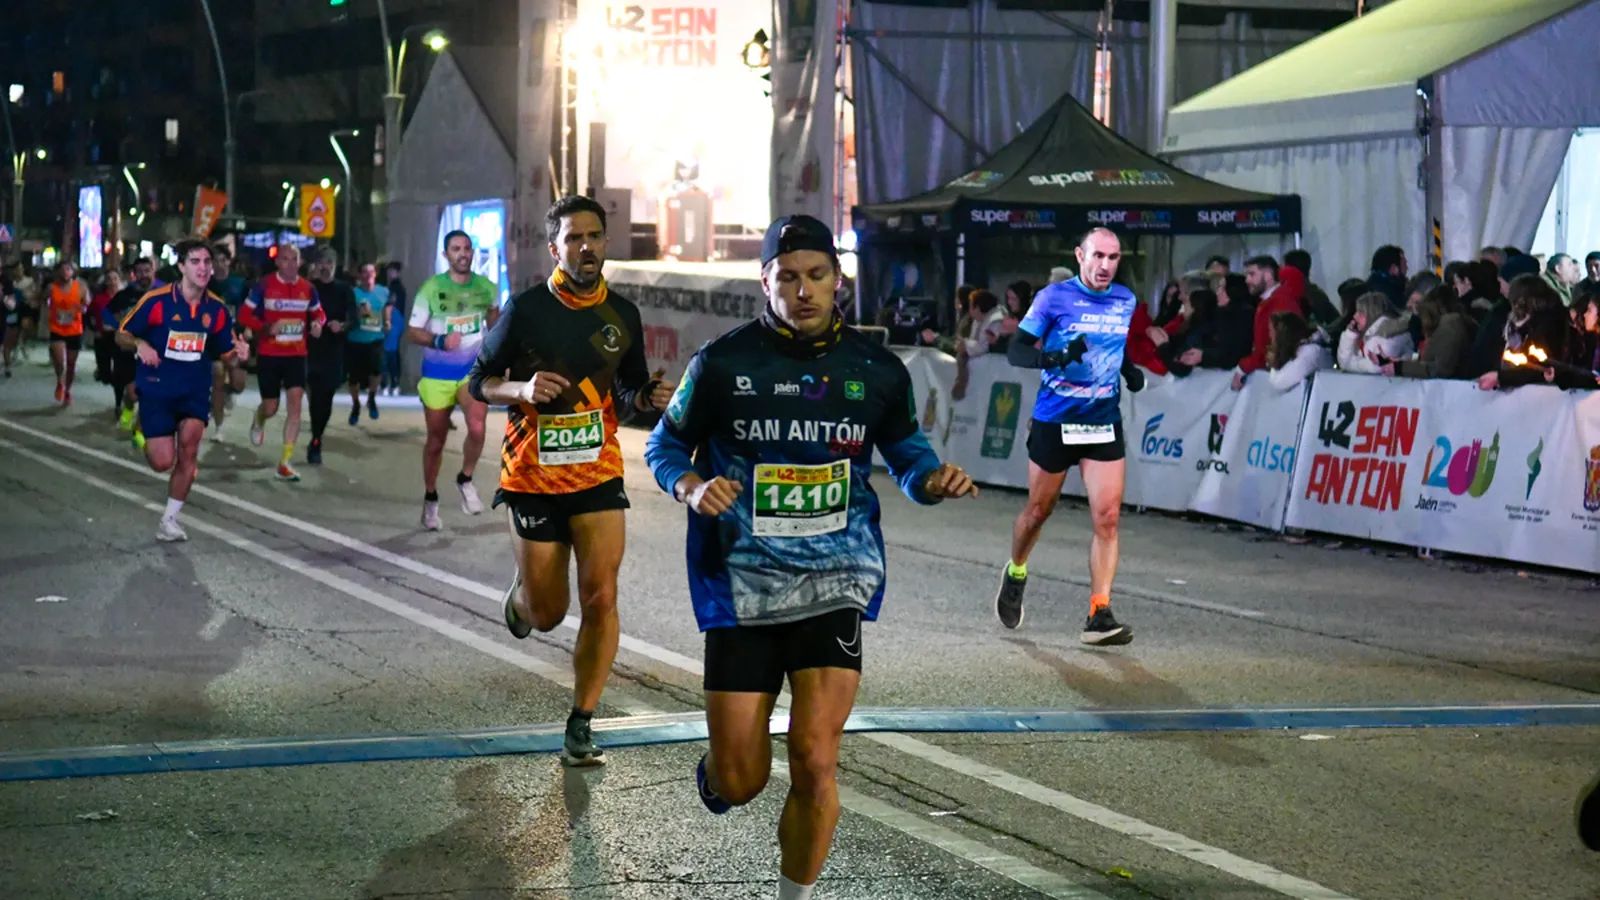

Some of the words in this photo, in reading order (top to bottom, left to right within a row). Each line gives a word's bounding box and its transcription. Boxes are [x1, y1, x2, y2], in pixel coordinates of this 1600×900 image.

[651, 7, 717, 36] SAN
[543, 424, 601, 447] 2044
[733, 419, 780, 441] SAN
[787, 417, 867, 445] ANTÓN
[1141, 413, 1184, 458] Forus
[1318, 400, 1356, 450] 42
[1352, 406, 1420, 457] SAN
[1247, 436, 1296, 474] alsa
[777, 467, 796, 481] 42
[1304, 453, 1407, 512] ANTON
[763, 482, 843, 511] 1410
[1414, 493, 1439, 512] Jaén
